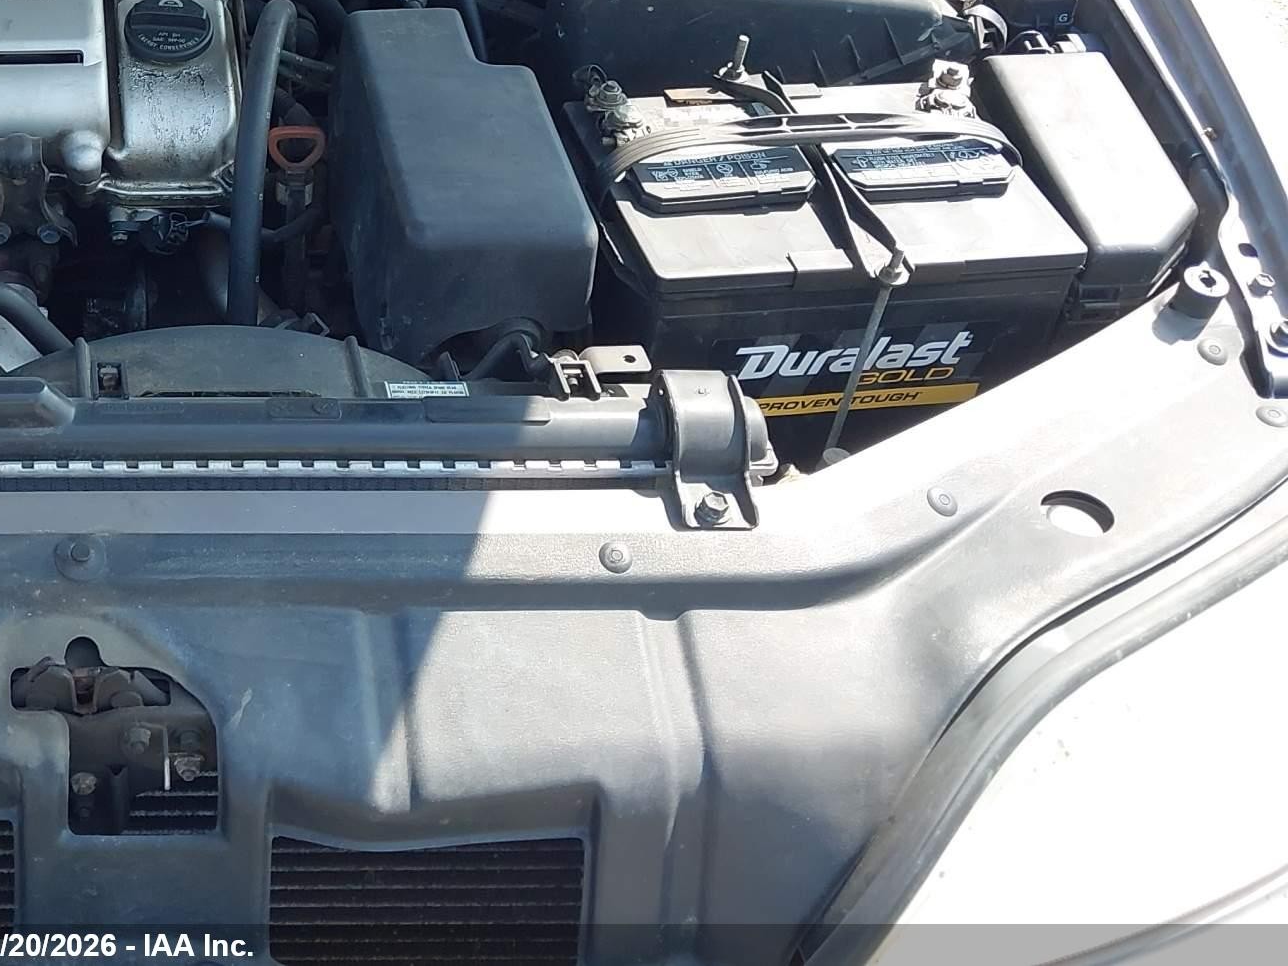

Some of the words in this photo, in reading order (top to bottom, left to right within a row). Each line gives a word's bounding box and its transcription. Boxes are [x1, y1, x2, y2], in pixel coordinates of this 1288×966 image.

[673, 155, 716, 166] DANGER
[727, 151, 767, 161] POISON
[736, 332, 970, 380] Duralast
[858, 367, 954, 385] GOLD
[759, 397, 842, 411] PROVEN
[850, 391, 921, 405] TOUGH
